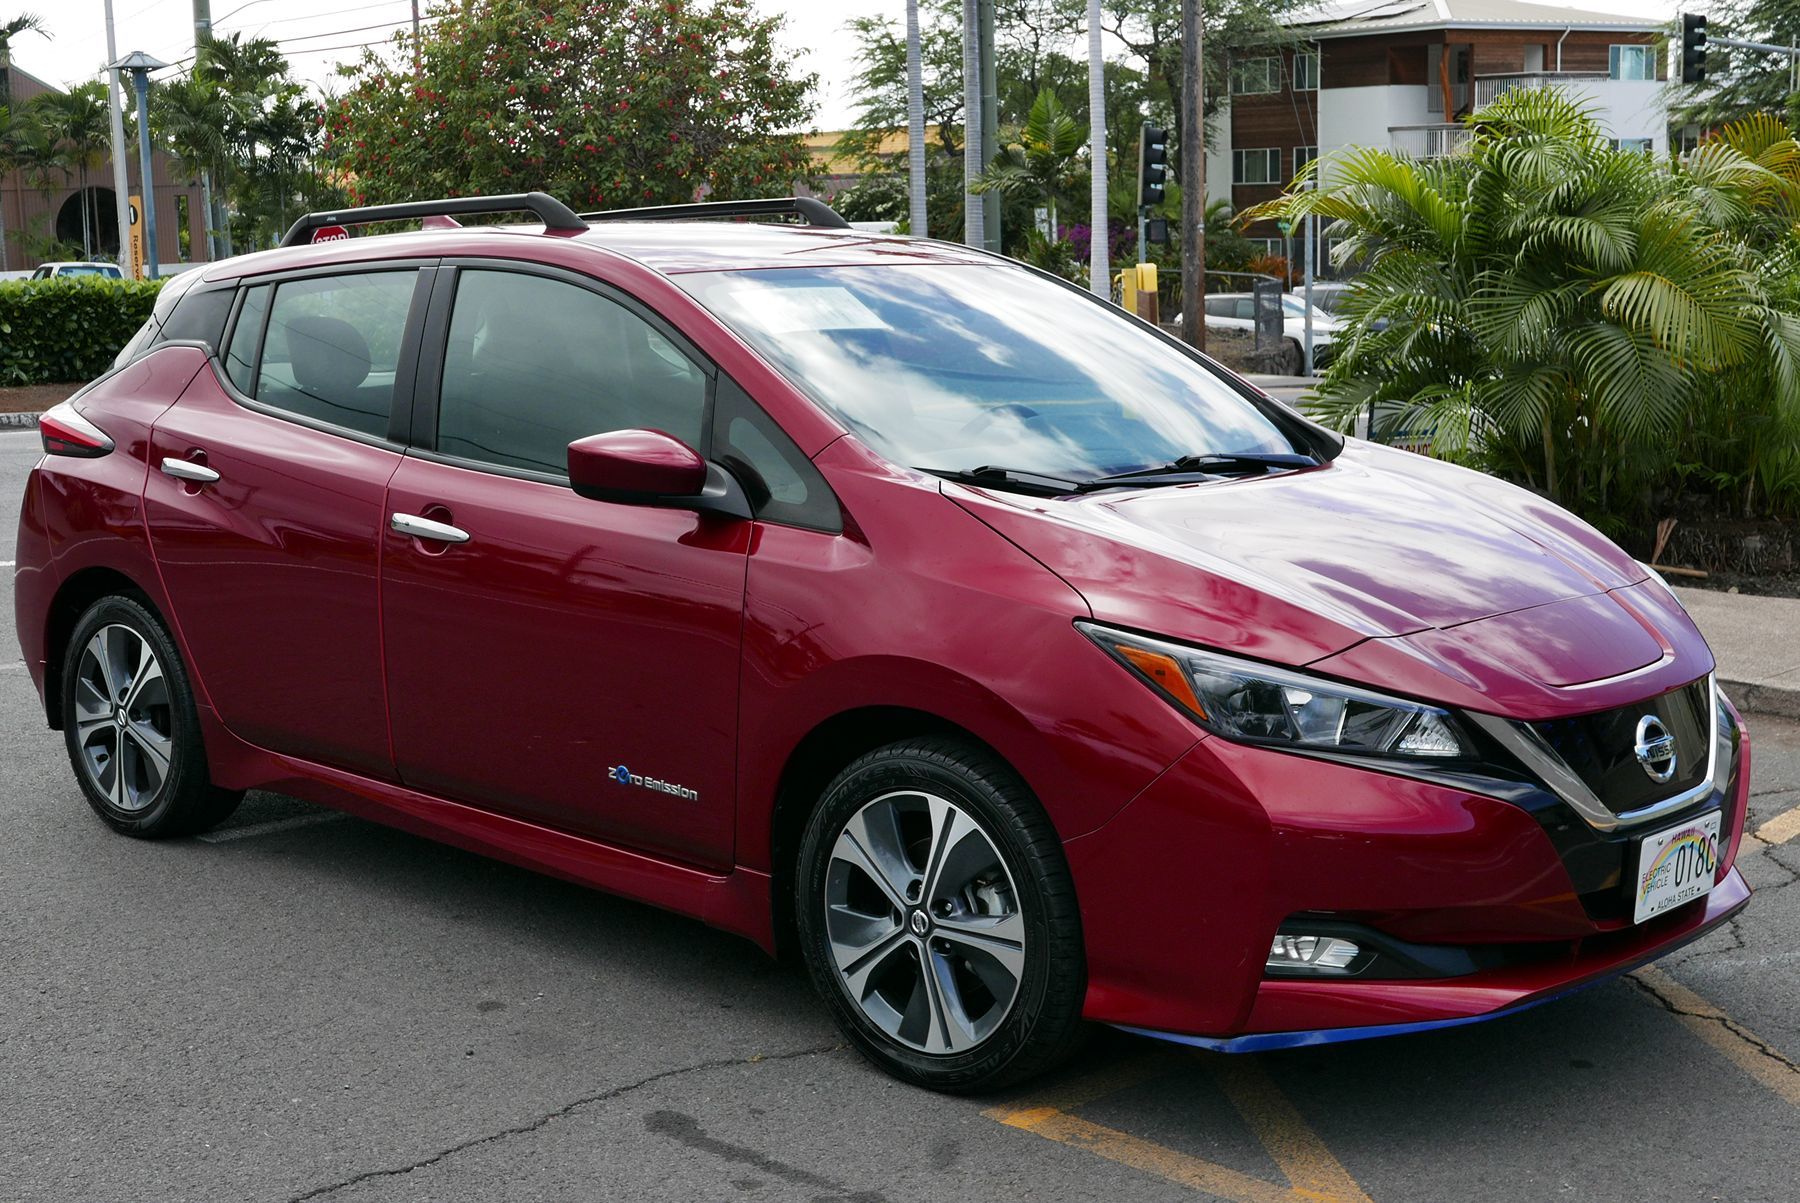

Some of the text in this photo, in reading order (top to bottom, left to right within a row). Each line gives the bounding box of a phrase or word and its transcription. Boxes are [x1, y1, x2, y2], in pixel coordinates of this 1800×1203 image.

[644, 776, 698, 801] Emission
[1675, 833, 1717, 887] 018C
[1642, 862, 1672, 884] ELECTRIC
[1642, 876, 1668, 895] VEHICLE
[1657, 886, 1695, 909] ALOHA STATE
